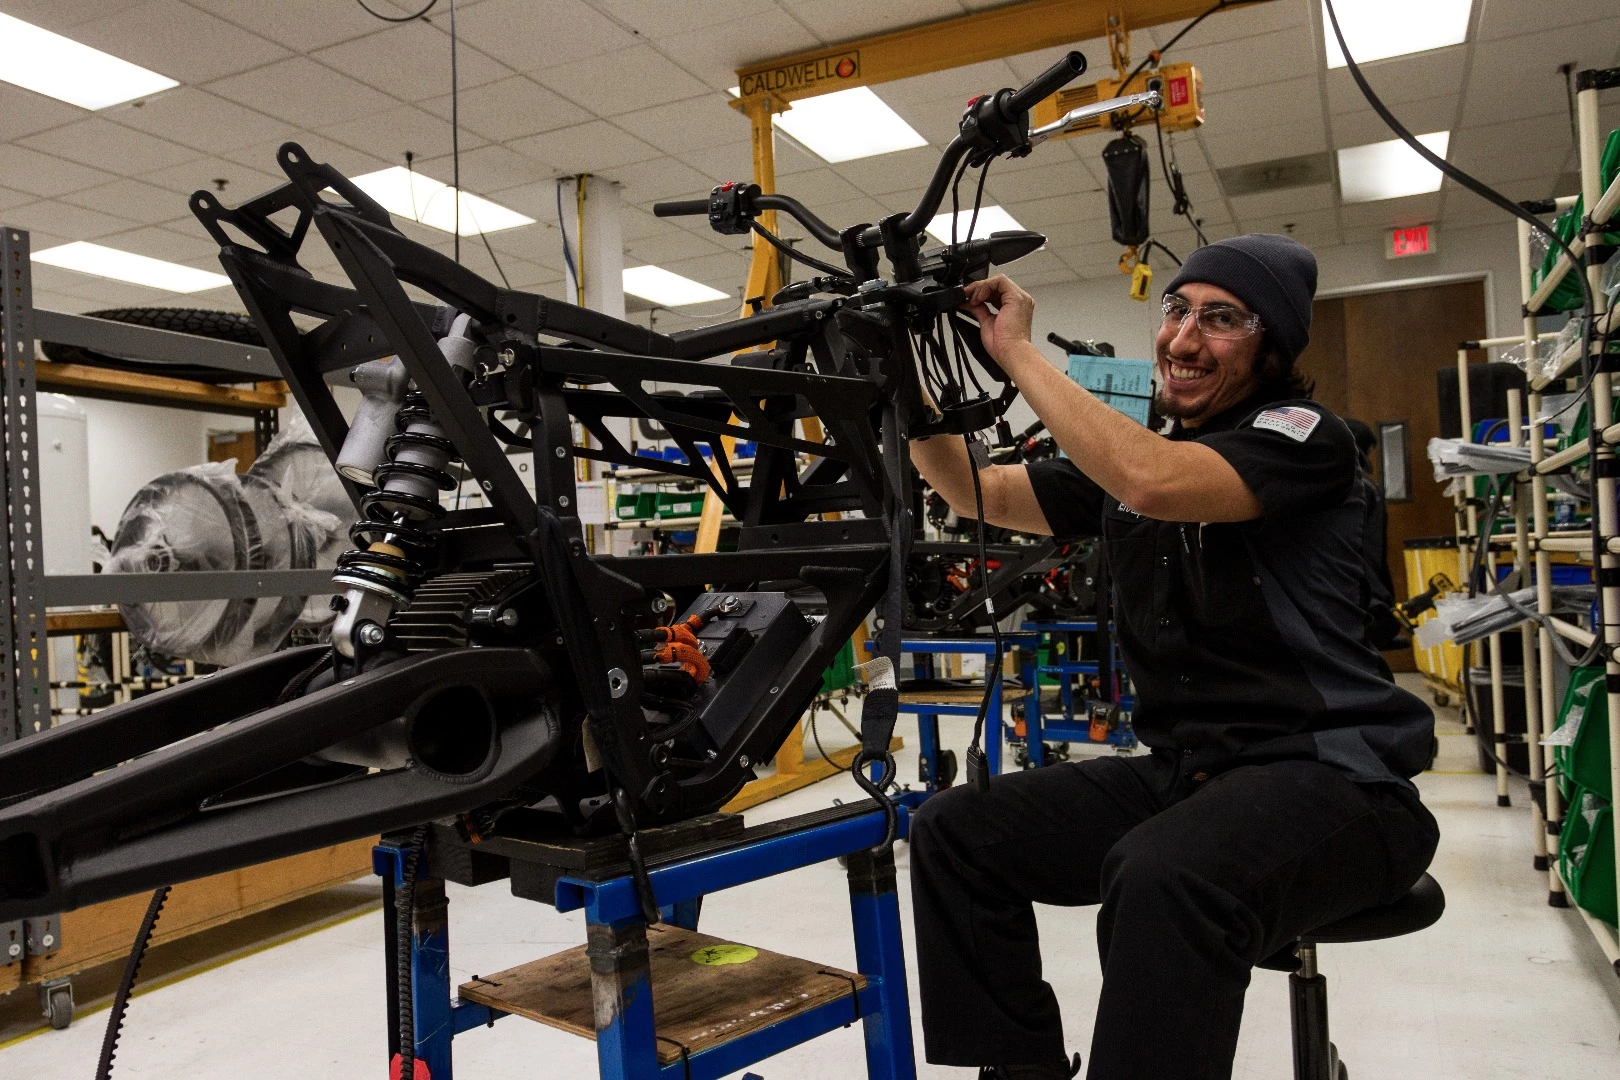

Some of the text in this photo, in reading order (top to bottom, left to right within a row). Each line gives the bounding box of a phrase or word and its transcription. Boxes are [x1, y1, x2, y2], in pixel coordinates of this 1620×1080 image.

[742, 59, 835, 96] CALDWELL
[1393, 225, 1429, 257] EXIT
[1256, 420, 1304, 438] CALIFORNIA
[1259, 417, 1296, 430] CRAFTED
